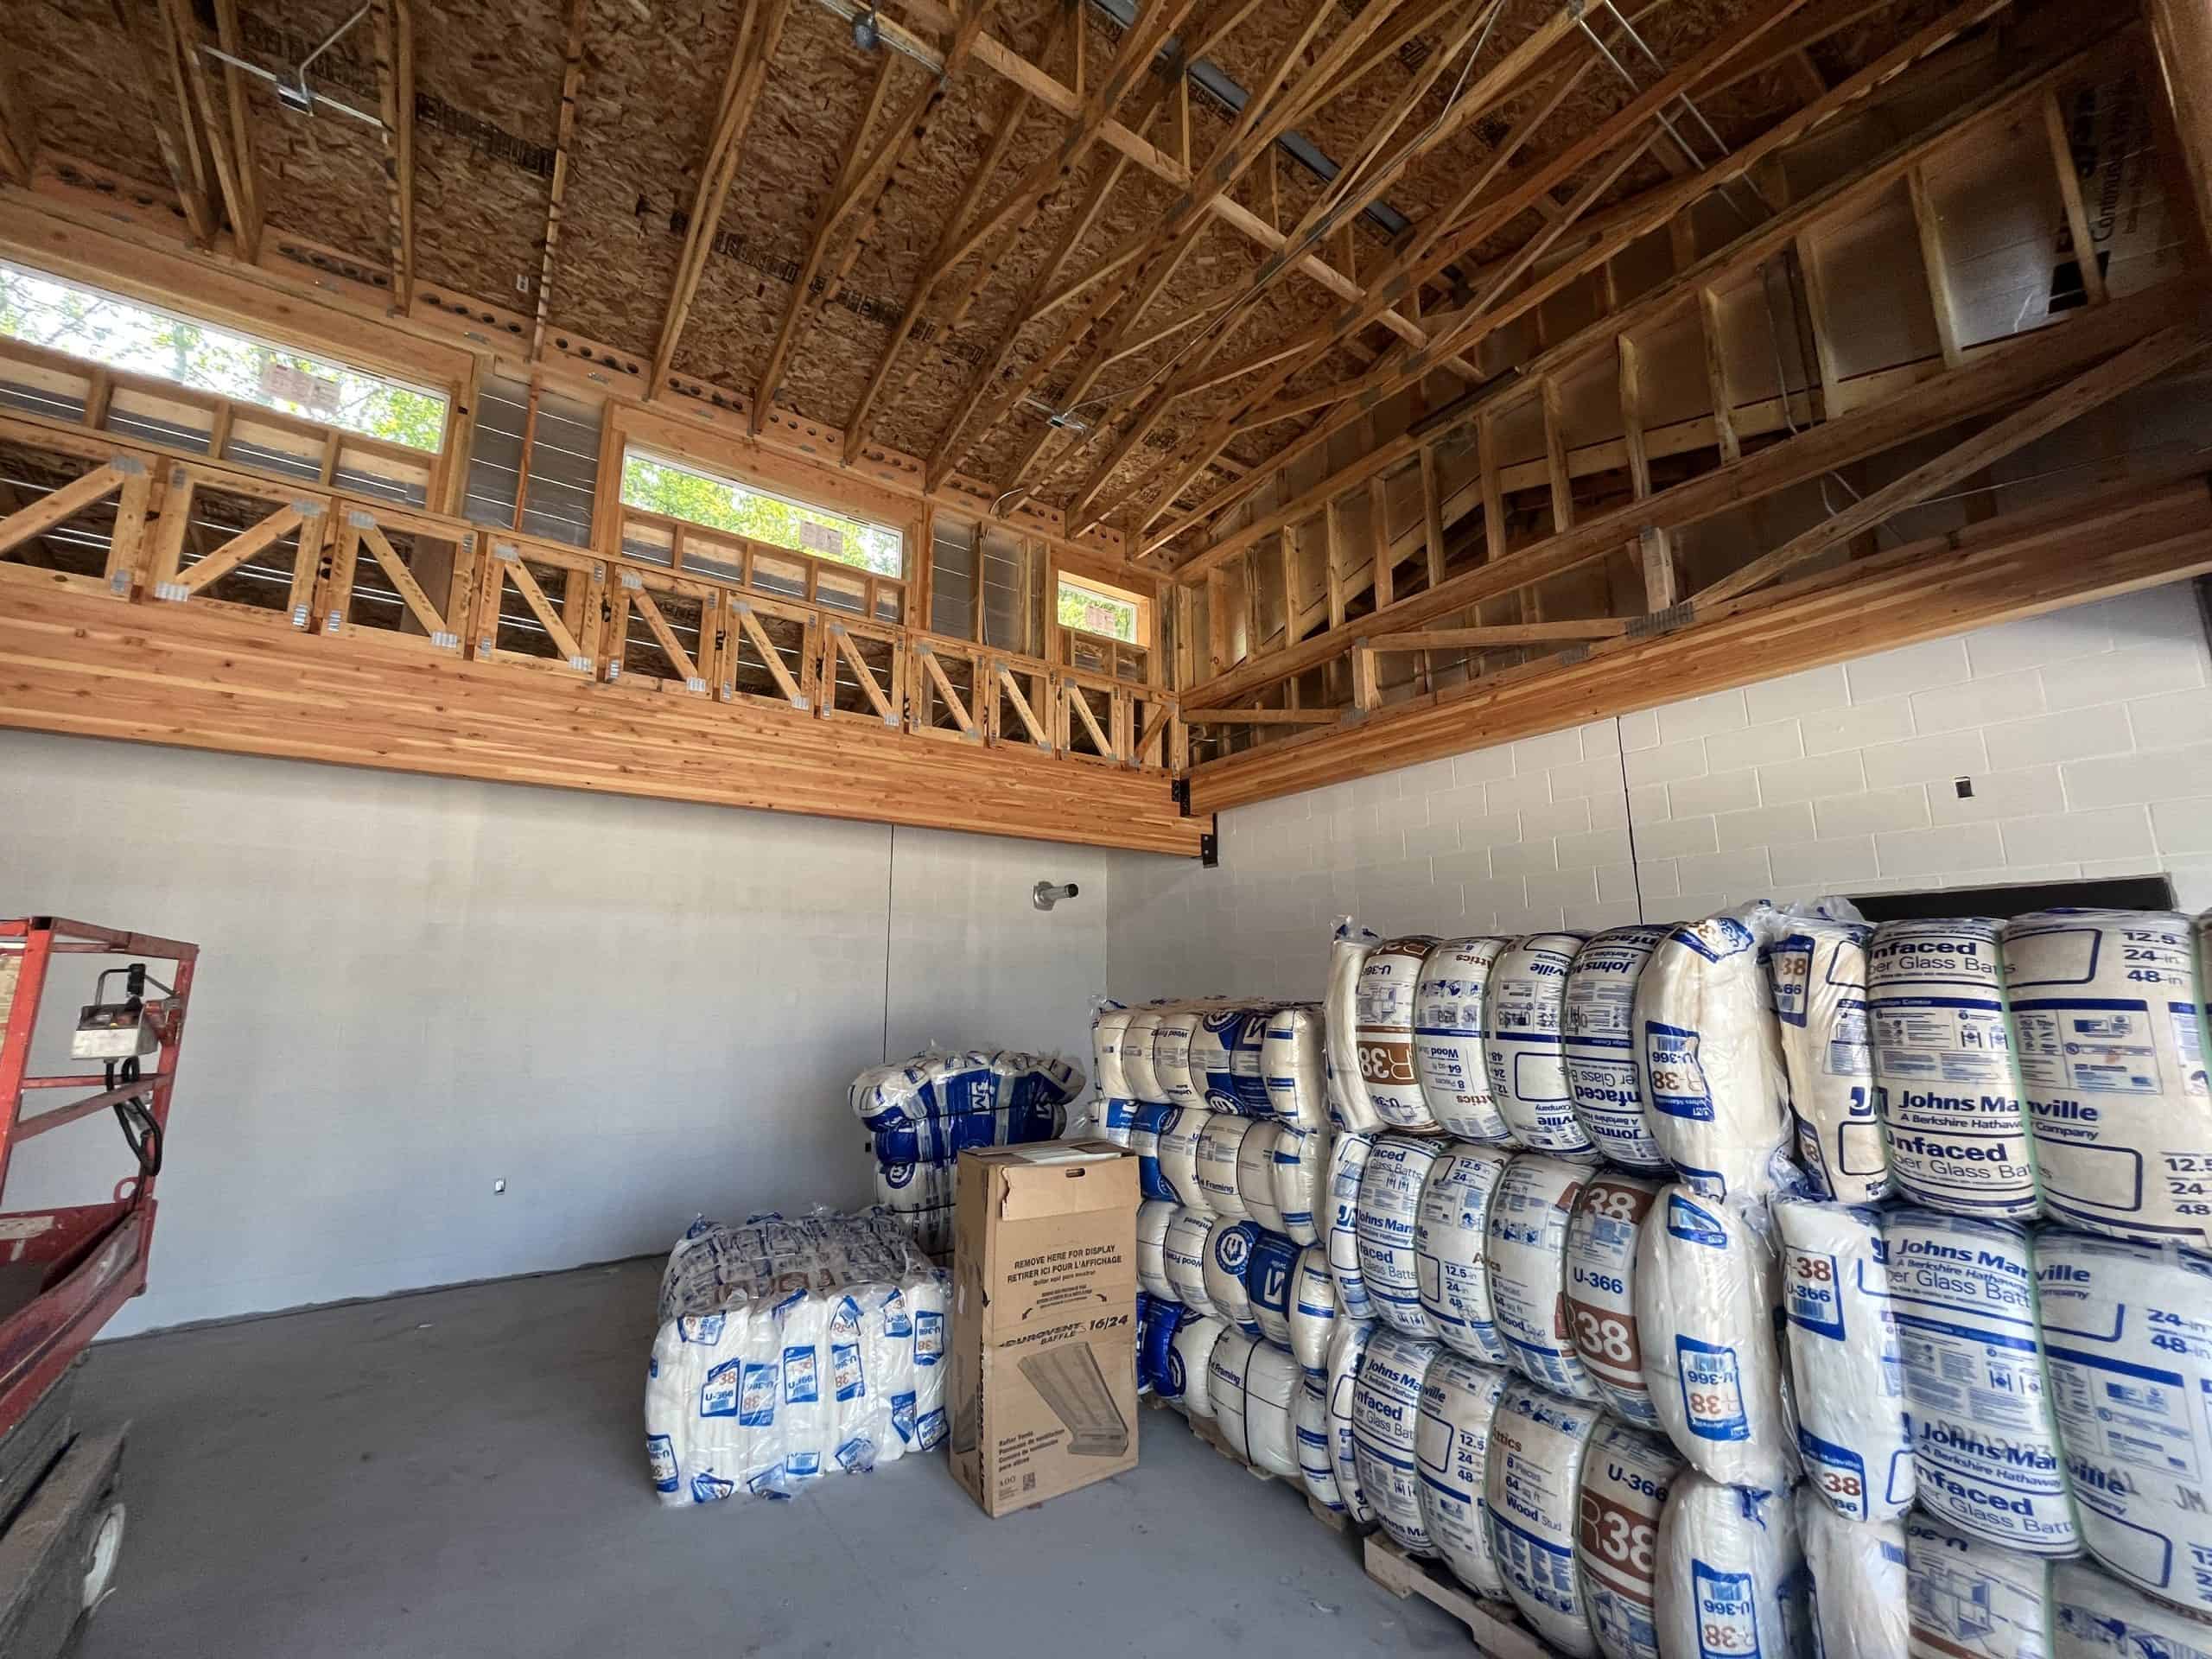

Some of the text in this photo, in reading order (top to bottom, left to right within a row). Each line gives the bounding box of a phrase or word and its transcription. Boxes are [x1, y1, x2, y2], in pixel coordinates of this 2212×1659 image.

[1782, 957, 1806, 976] 38
[1898, 957, 1955, 970] Glass
[1430, 1046, 1459, 1059] Wood
[1651, 1051, 1694, 1064] U-366
[1447, 1064, 1462, 1074] 64
[1582, 1071, 1616, 1087] Glass
[1574, 1084, 1643, 1107] nfaced
[1898, 1090, 1975, 1111] Johns
[1536, 1115, 1576, 1127] ville
[1900, 1113, 1910, 1122] A
[1912, 1113, 1970, 1128] Berkshire
[2035, 1122, 2100, 1141] Company
[1929, 1158, 1992, 1179] Glass
[2170, 1181, 2203, 1195] 24
[2175, 1204, 2212, 1216] 48
[1014, 1244, 1116, 1269] REMOVE HERE FOR DISPLAY
[1896, 1238, 1973, 1262] Johns
[1007, 1255, 1122, 1284] RETIRER ICI POUR L'AFFICHAGE
[1388, 1267, 1418, 1281] Batts
[1907, 1258, 1963, 1275] Berkshire
[1573, 1266, 1624, 1294] U-366
[1915, 1268, 1977, 1295] Glass
[1985, 1280, 2031, 1308] Batt
[1366, 1359, 1401, 1382] Johns
[1687, 1370, 1734, 1385] U-366
[1365, 1409, 1392, 1433] Glass
[1459, 1433, 1486, 1451] 12.5
[1920, 1421, 2002, 1461] Johns
[1458, 1451, 1472, 1465] 24
[1506, 1457, 1515, 1469] 8
[1934, 1447, 1993, 1475] Berkshire
[1458, 1469, 1473, 1483] 48
[1505, 1475, 1520, 1491] 64
[1607, 1462, 1670, 1503] U-366
[1823, 1472, 1862, 1497] 38
[1914, 1462, 2035, 1516] nfaced
[1506, 1494, 1539, 1522] Wood
[1948, 1497, 2075, 1534] Glass Batt
[1703, 1599, 1750, 1616] U-366
